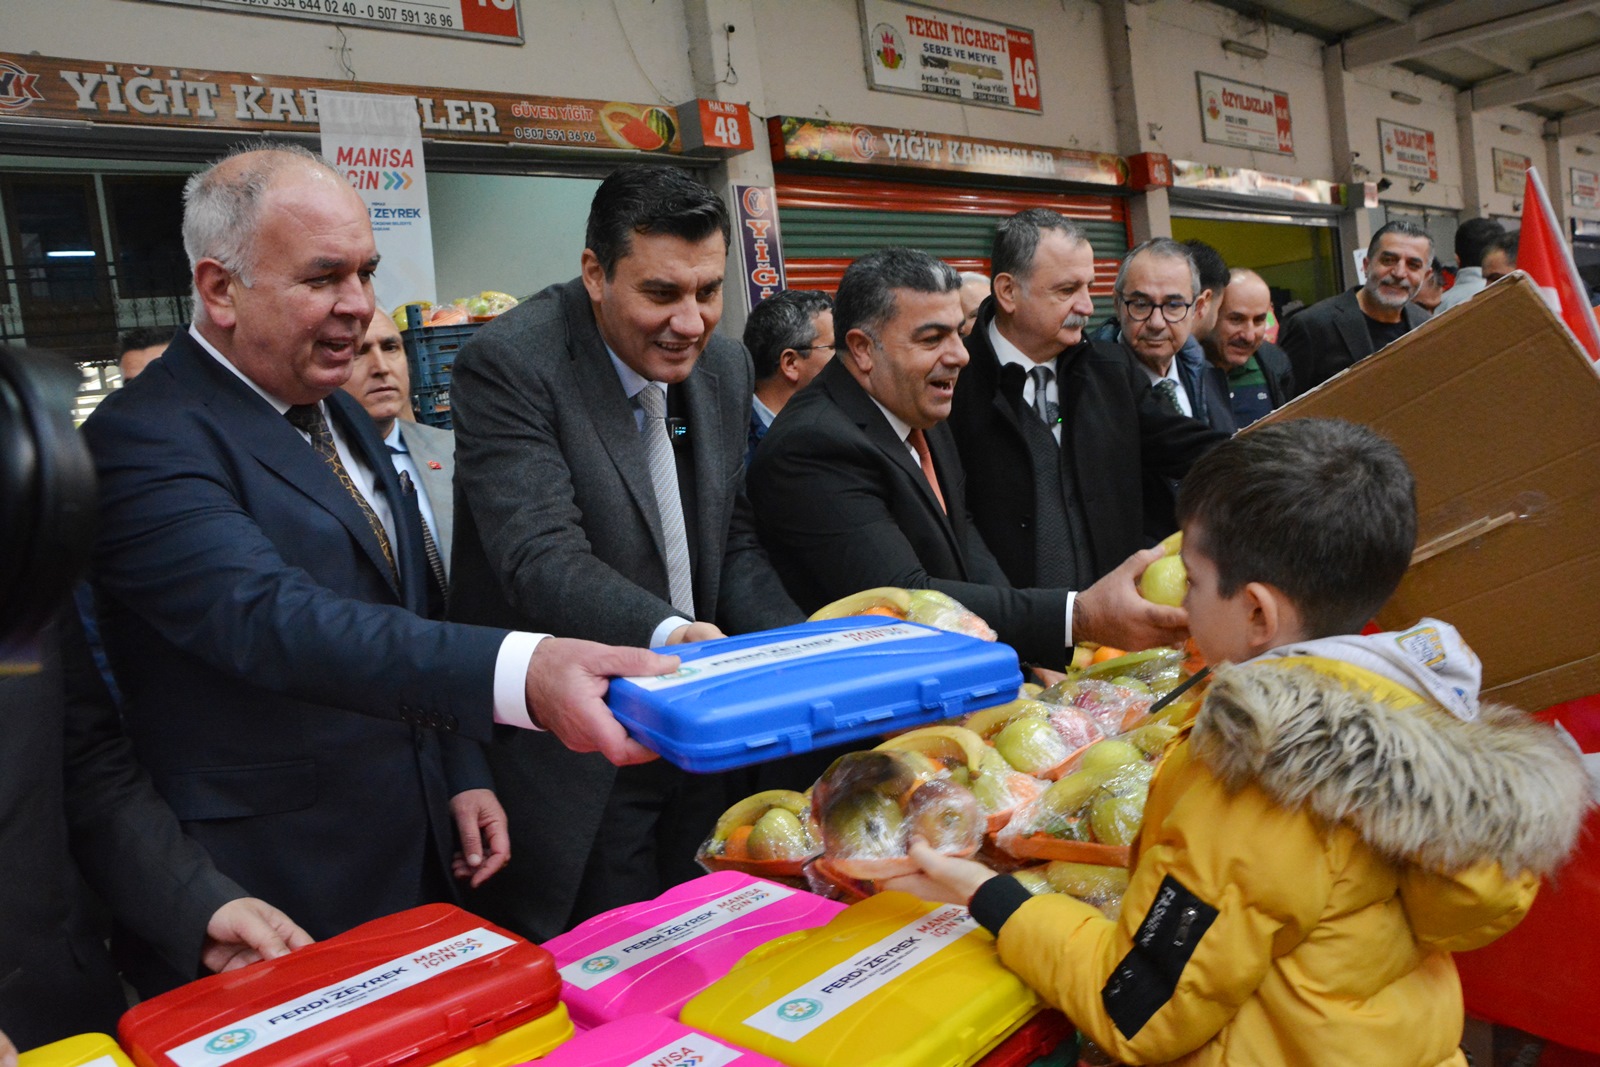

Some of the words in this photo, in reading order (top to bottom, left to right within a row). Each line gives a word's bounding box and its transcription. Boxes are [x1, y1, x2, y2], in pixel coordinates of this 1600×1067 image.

[300, 0, 321, 11] 644
[325, 1, 339, 13] 02
[342, 2, 357, 15] 40
[367, 5, 375, 18] 0
[378, 6, 397, 20] 507
[401, 9, 420, 24] 591
[424, 12, 437, 26] 36
[440, 14, 453, 27] 96
[906, 15, 949, 41] TEKİN
[951, 21, 1006, 52] TİCARET
[923, 43, 953, 57] SEBZE
[954, 48, 965, 59] VE
[967, 51, 997, 65] MEYVE
[1014, 57, 1037, 97] 46
[59, 64, 219, 118] YİĞİT
[511, 101, 557, 119] GÜVEN
[559, 104, 593, 121] YİĞİT
[708, 100, 724, 113] HAL
[514, 126, 522, 138] 0
[523, 127, 544, 139] 507
[545, 129, 566, 141] 591
[568, 130, 581, 141] 36
[583, 131, 596, 142] 96
[714, 116, 741, 146] 48
[336, 146, 414, 168] MANİSA
[883, 128, 942, 162] YİĞİT
[374, 208, 422, 218] ZEYREK
[717, 887, 763, 910] MANİSA
[727, 899, 752, 914] İÇİN
[622, 934, 663, 954] FERDİ
[665, 910, 718, 936] ZEYREK
[916, 907, 965, 934] MANİSA
[929, 920, 960, 939] İÇİN
[412, 937, 478, 965] MANİSA
[423, 950, 458, 970] İÇİN
[821, 967, 867, 994] FERDİ
[863, 936, 921, 969] ZEYREK
[267, 997, 330, 1026] FERDİ
[332, 966, 409, 1000] ZEYREK
